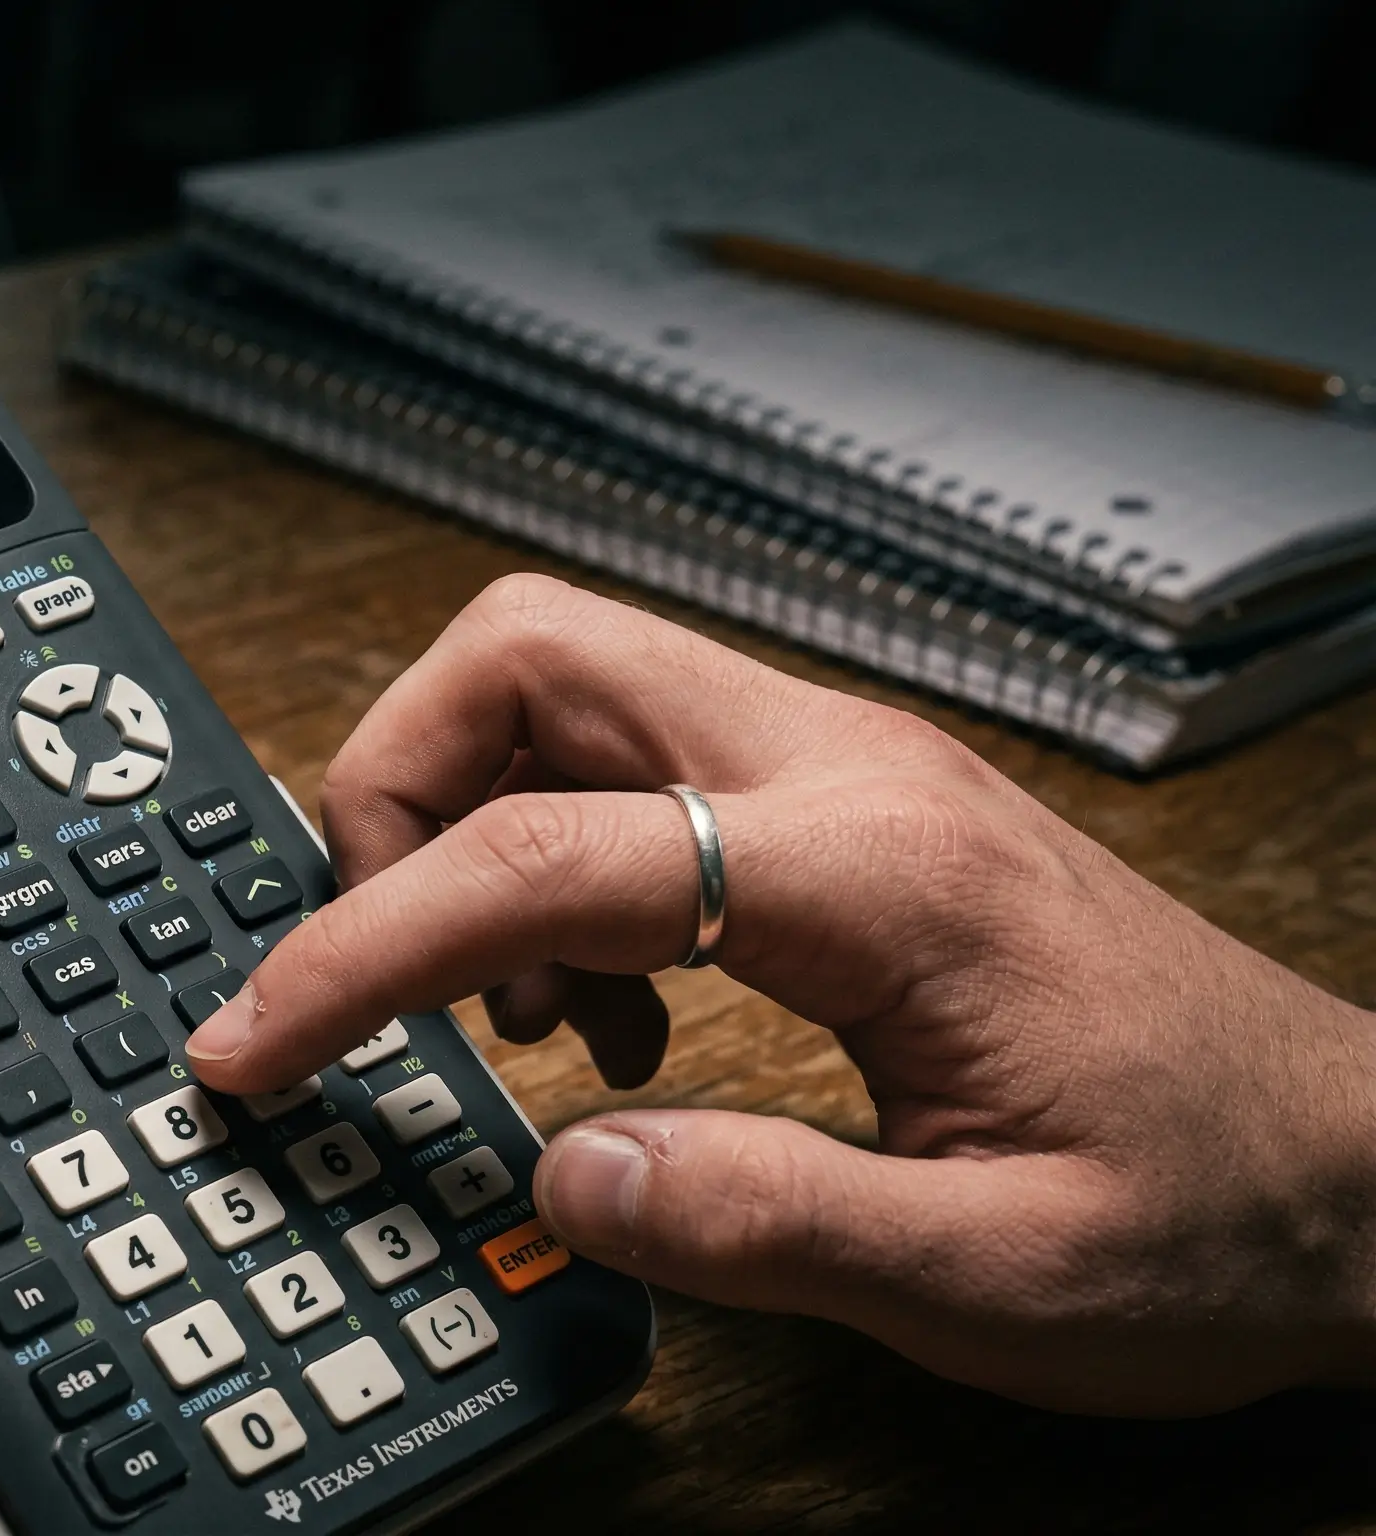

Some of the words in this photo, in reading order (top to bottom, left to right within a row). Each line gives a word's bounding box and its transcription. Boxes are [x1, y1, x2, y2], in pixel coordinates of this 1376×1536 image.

[33, 583, 87, 617] graph
[185, 800, 238, 834] clear
[94, 839, 146, 870] vars
[250, 837, 270, 855] M
[162, 876, 178, 893] C
[65, 915, 81, 932] F
[150, 915, 191, 942] tan
[169, 1063, 187, 1080] G
[164, 1105, 199, 1141] 8
[60, 1149, 90, 1188] 7
[319, 1141, 353, 1178] 6
[168, 1165, 200, 1191] L5
[220, 1187, 256, 1225] 5
[66, 1213, 99, 1240] L4
[286, 1229, 304, 1247] 2
[377, 1224, 412, 1261] 3
[127, 1234, 157, 1270] 4
[227, 1250, 258, 1275] L2
[496, 1234, 560, 1274] ENTER
[280, 1273, 319, 1314] 2
[124, 1300, 153, 1326] L1
[182, 1322, 214, 1359] 1
[240, 1411, 275, 1451] 0
[299, 1455, 375, 1503] TEXAS
[371, 1377, 520, 1467] INSTRUMENTS
[124, 1449, 159, 1477] on
